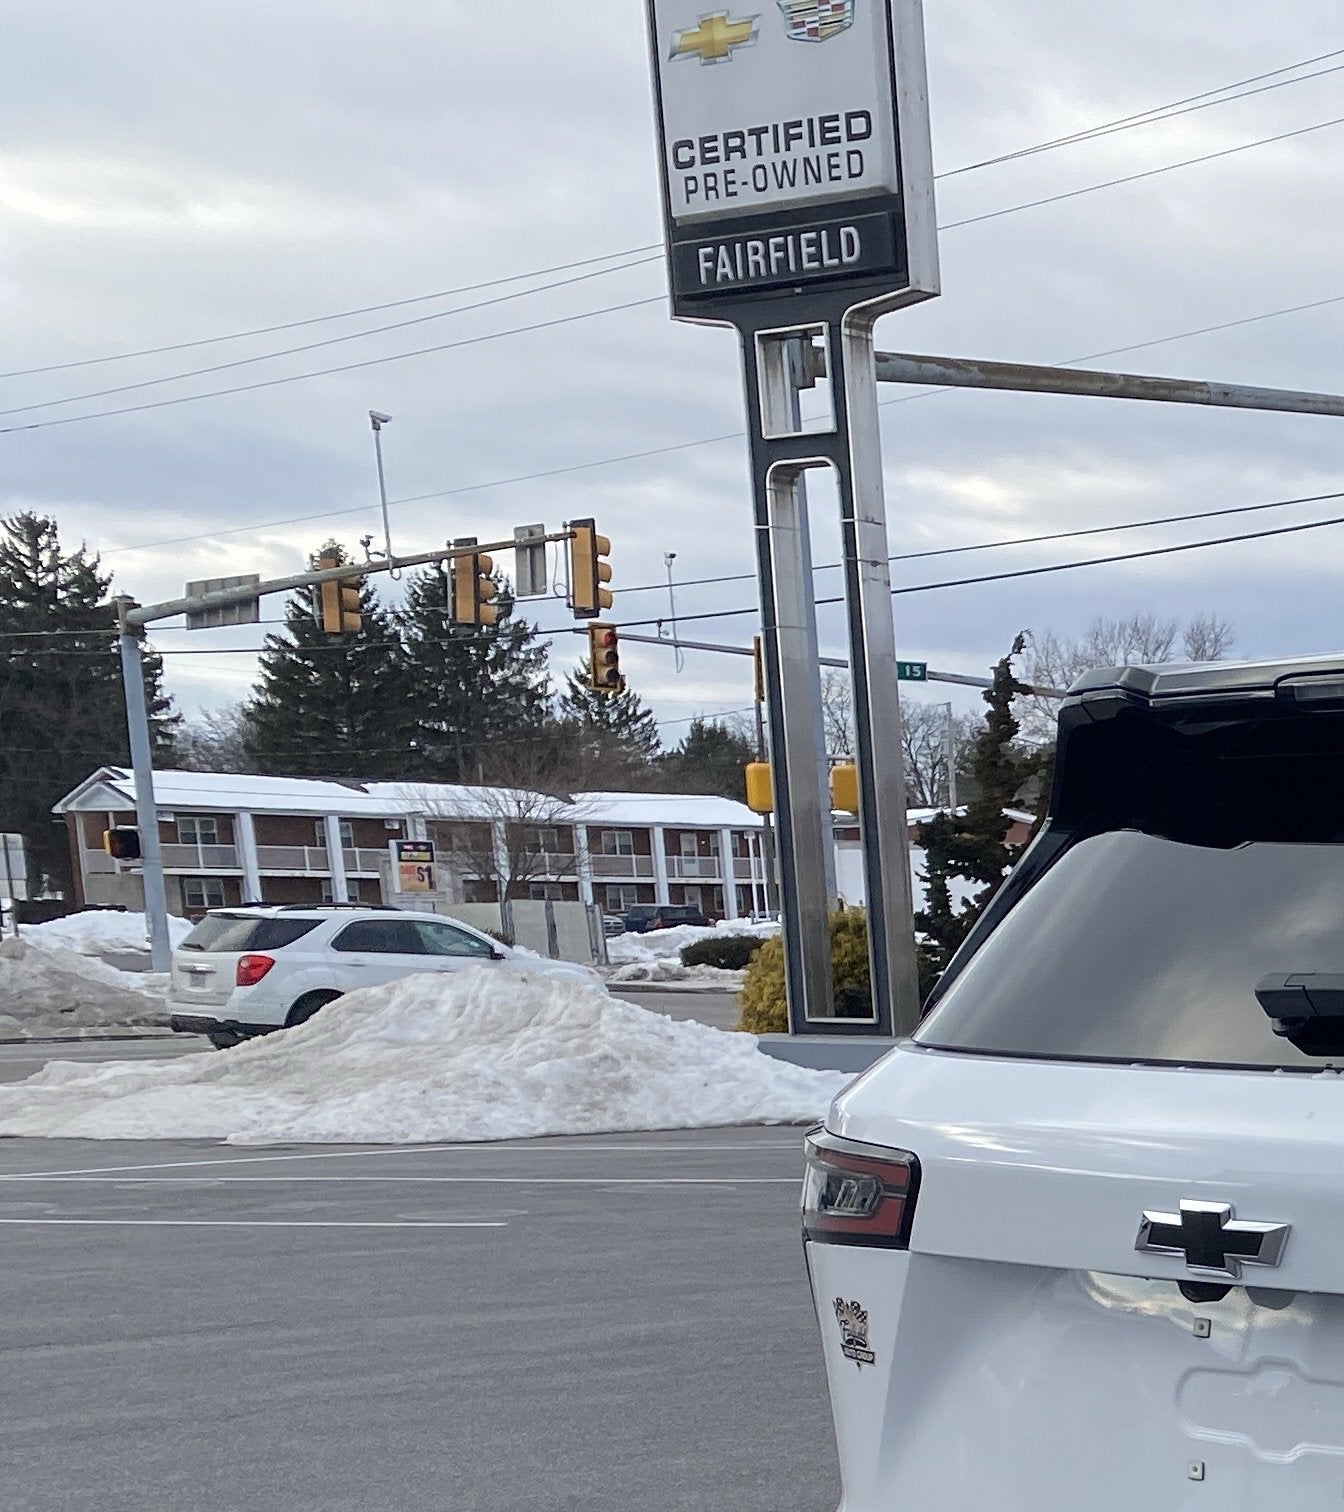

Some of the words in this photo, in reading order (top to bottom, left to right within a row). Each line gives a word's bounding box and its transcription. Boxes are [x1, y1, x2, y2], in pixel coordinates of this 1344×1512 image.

[672, 110, 872, 169] CERTIFIED
[685, 150, 863, 203] PRE-OWNED
[699, 226, 861, 284] FAIRFIELD
[905, 664, 921, 677] 15
